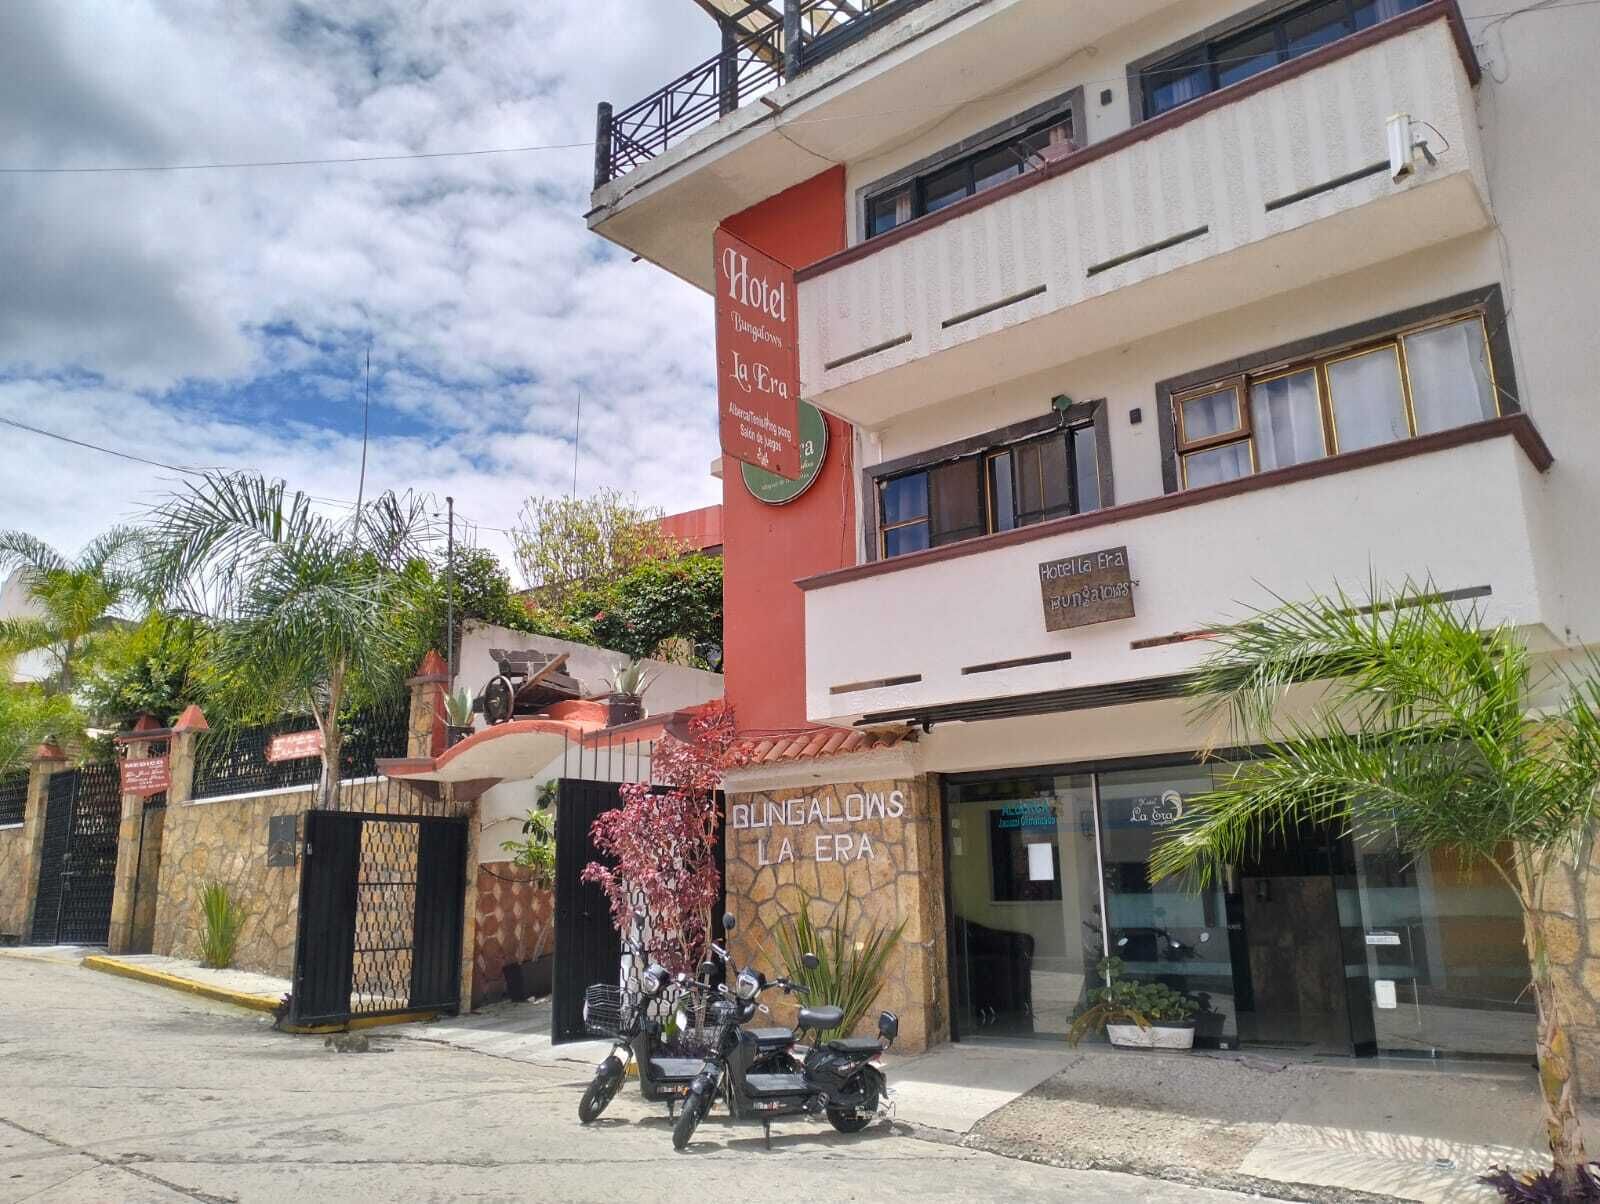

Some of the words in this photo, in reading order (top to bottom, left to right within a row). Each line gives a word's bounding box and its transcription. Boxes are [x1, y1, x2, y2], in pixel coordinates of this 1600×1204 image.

[722, 247, 787, 323] Hotel
[730, 310, 783, 348] Bungalows
[729, 350, 752, 393] La
[752, 362, 789, 400] Era
[1041, 559, 1075, 580] Hotel
[1097, 551, 1124, 569] Era
[732, 790, 904, 829] BUNGALOWS
[1130, 806, 1148, 822] La
[758, 837, 794, 865] LA
[815, 832, 875, 862] ERA
